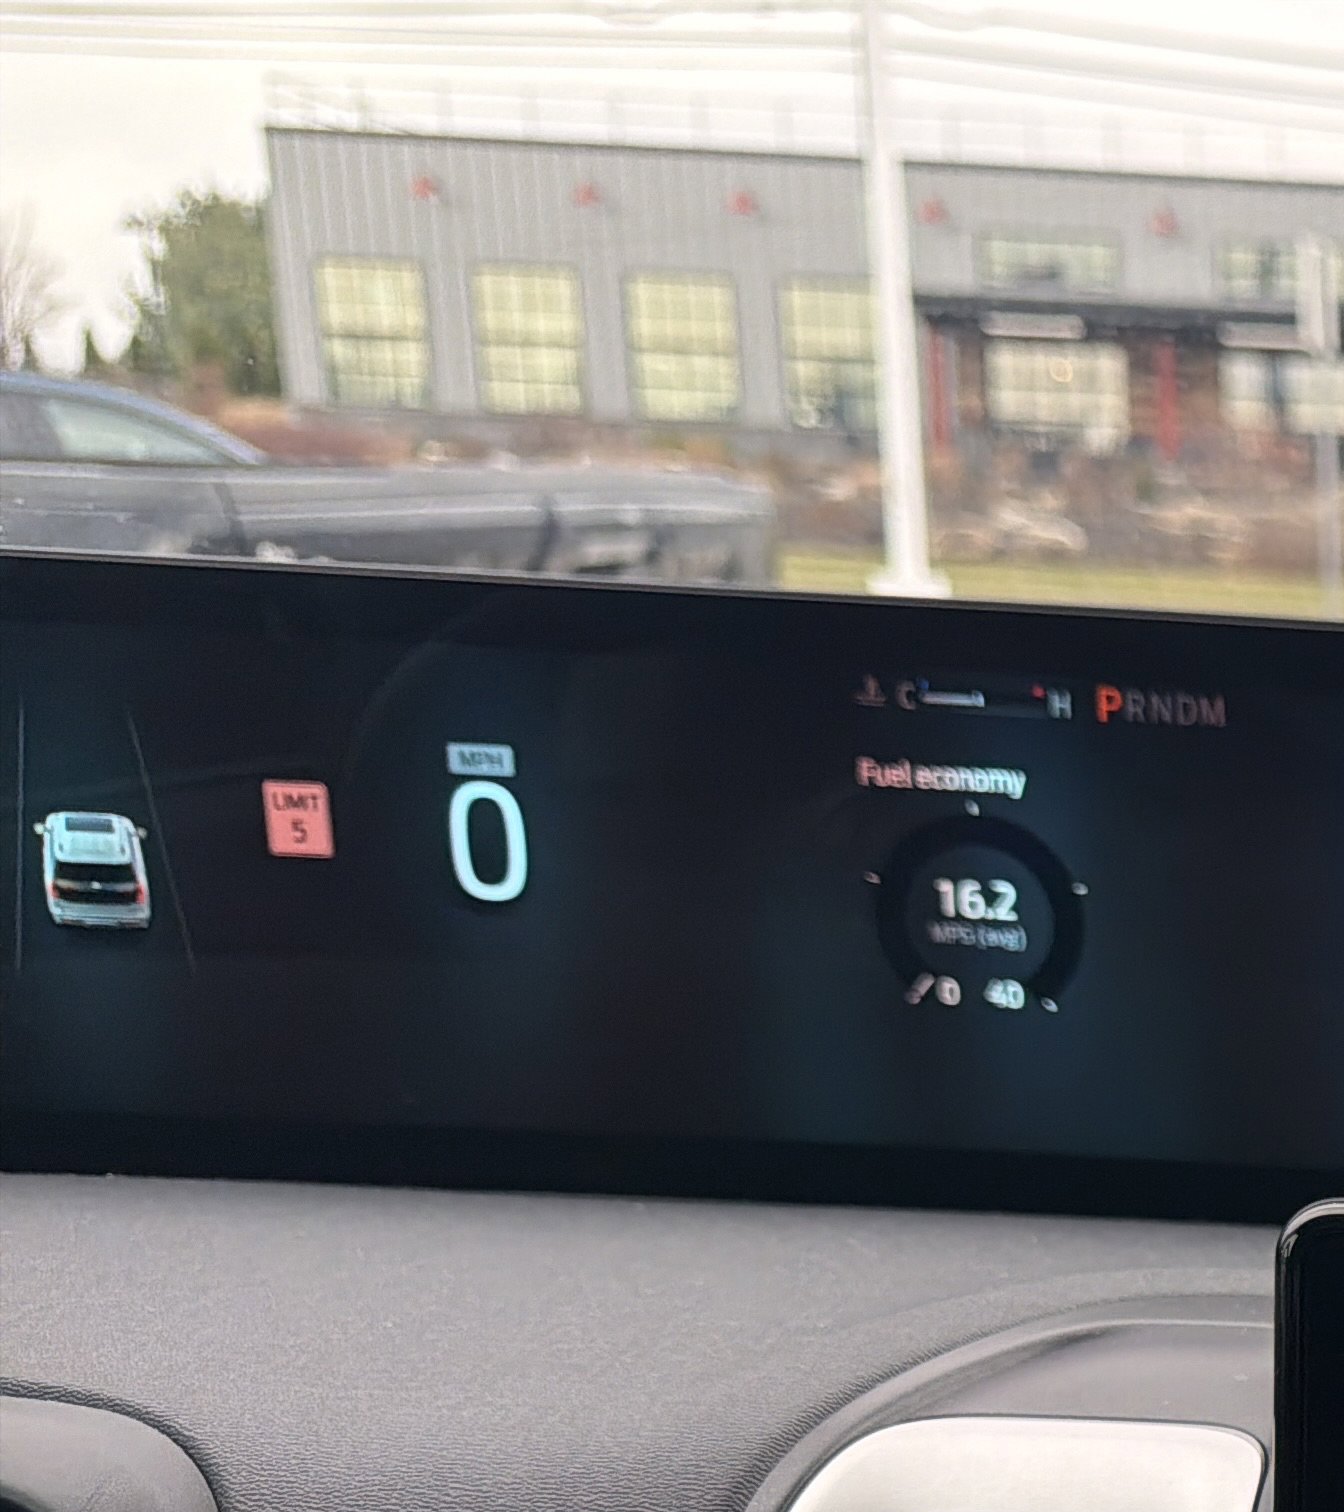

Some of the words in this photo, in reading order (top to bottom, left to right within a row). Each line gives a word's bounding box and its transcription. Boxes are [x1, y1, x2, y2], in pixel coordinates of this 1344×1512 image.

[856, 756, 913, 789] Fuel
[914, 764, 1027, 800] economy
[272, 792, 319, 812] LIMIT
[291, 819, 308, 843] 5
[449, 780, 528, 902] 0
[933, 877, 1018, 921] 16.2
